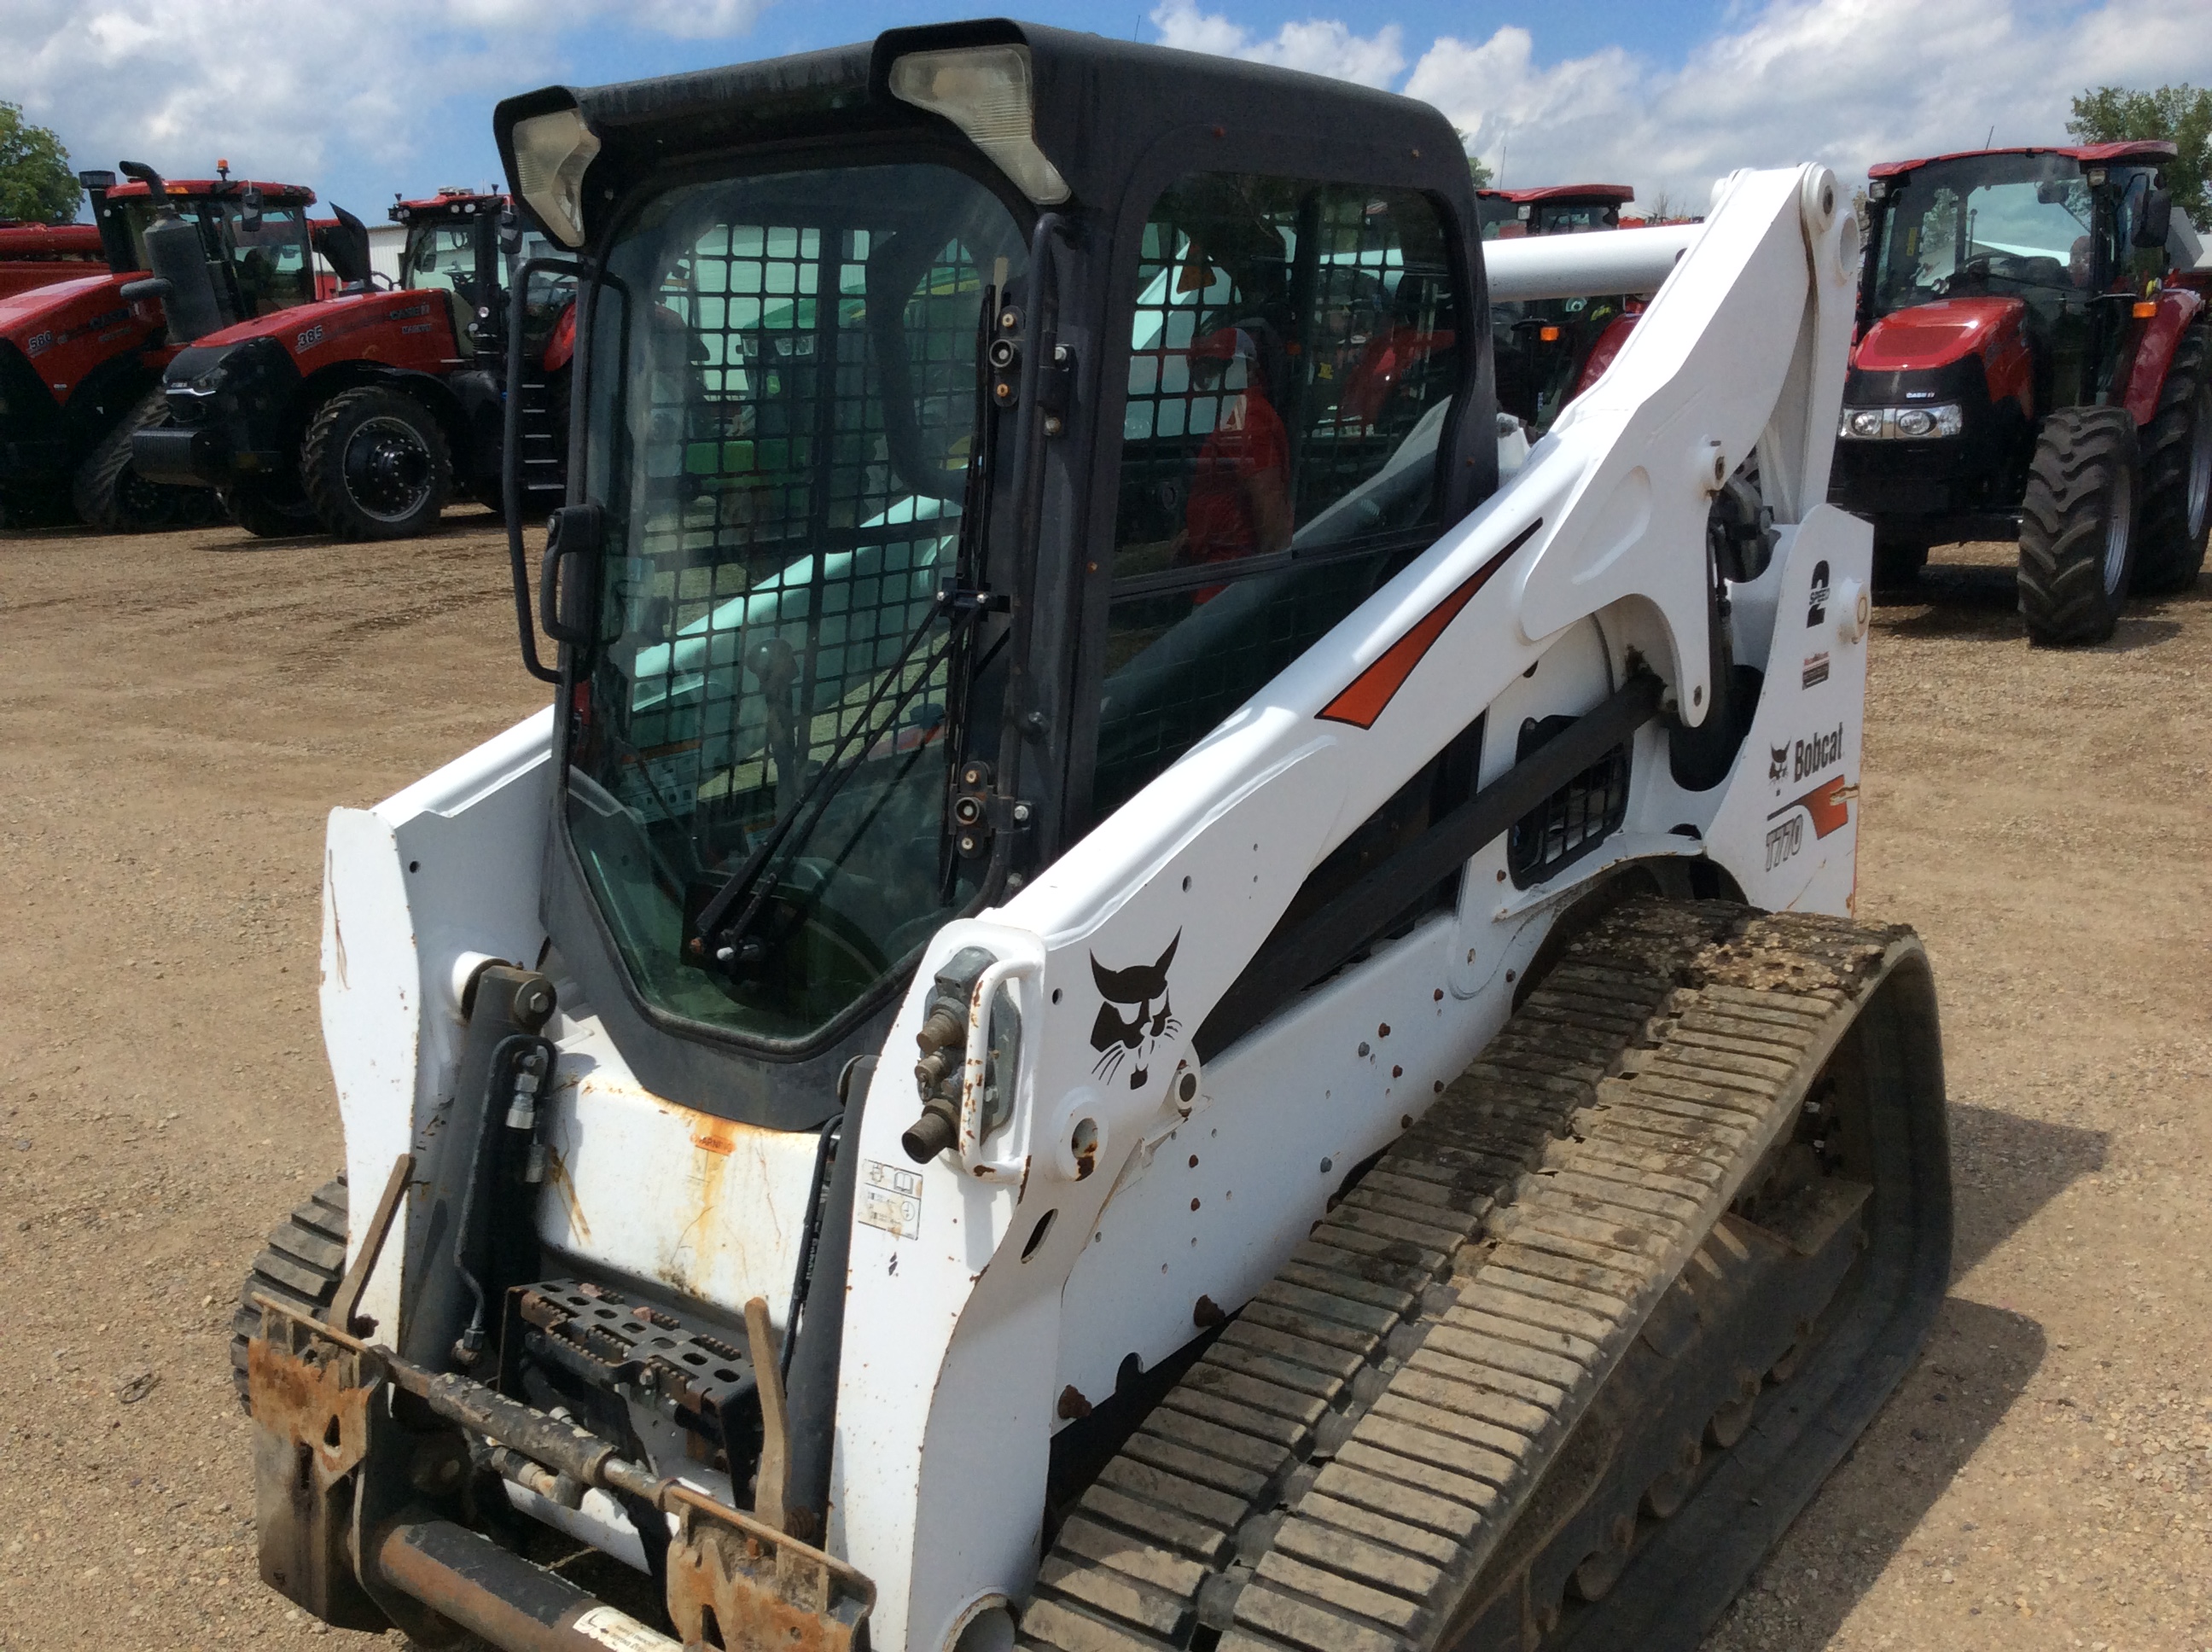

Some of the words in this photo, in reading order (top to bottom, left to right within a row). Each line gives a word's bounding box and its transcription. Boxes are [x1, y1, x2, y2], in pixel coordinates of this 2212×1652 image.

[29, 330, 53, 351] 580
[297, 325, 323, 346] 385
[1794, 722, 1842, 783] Bobcat
[1766, 814, 1803, 872] T770
